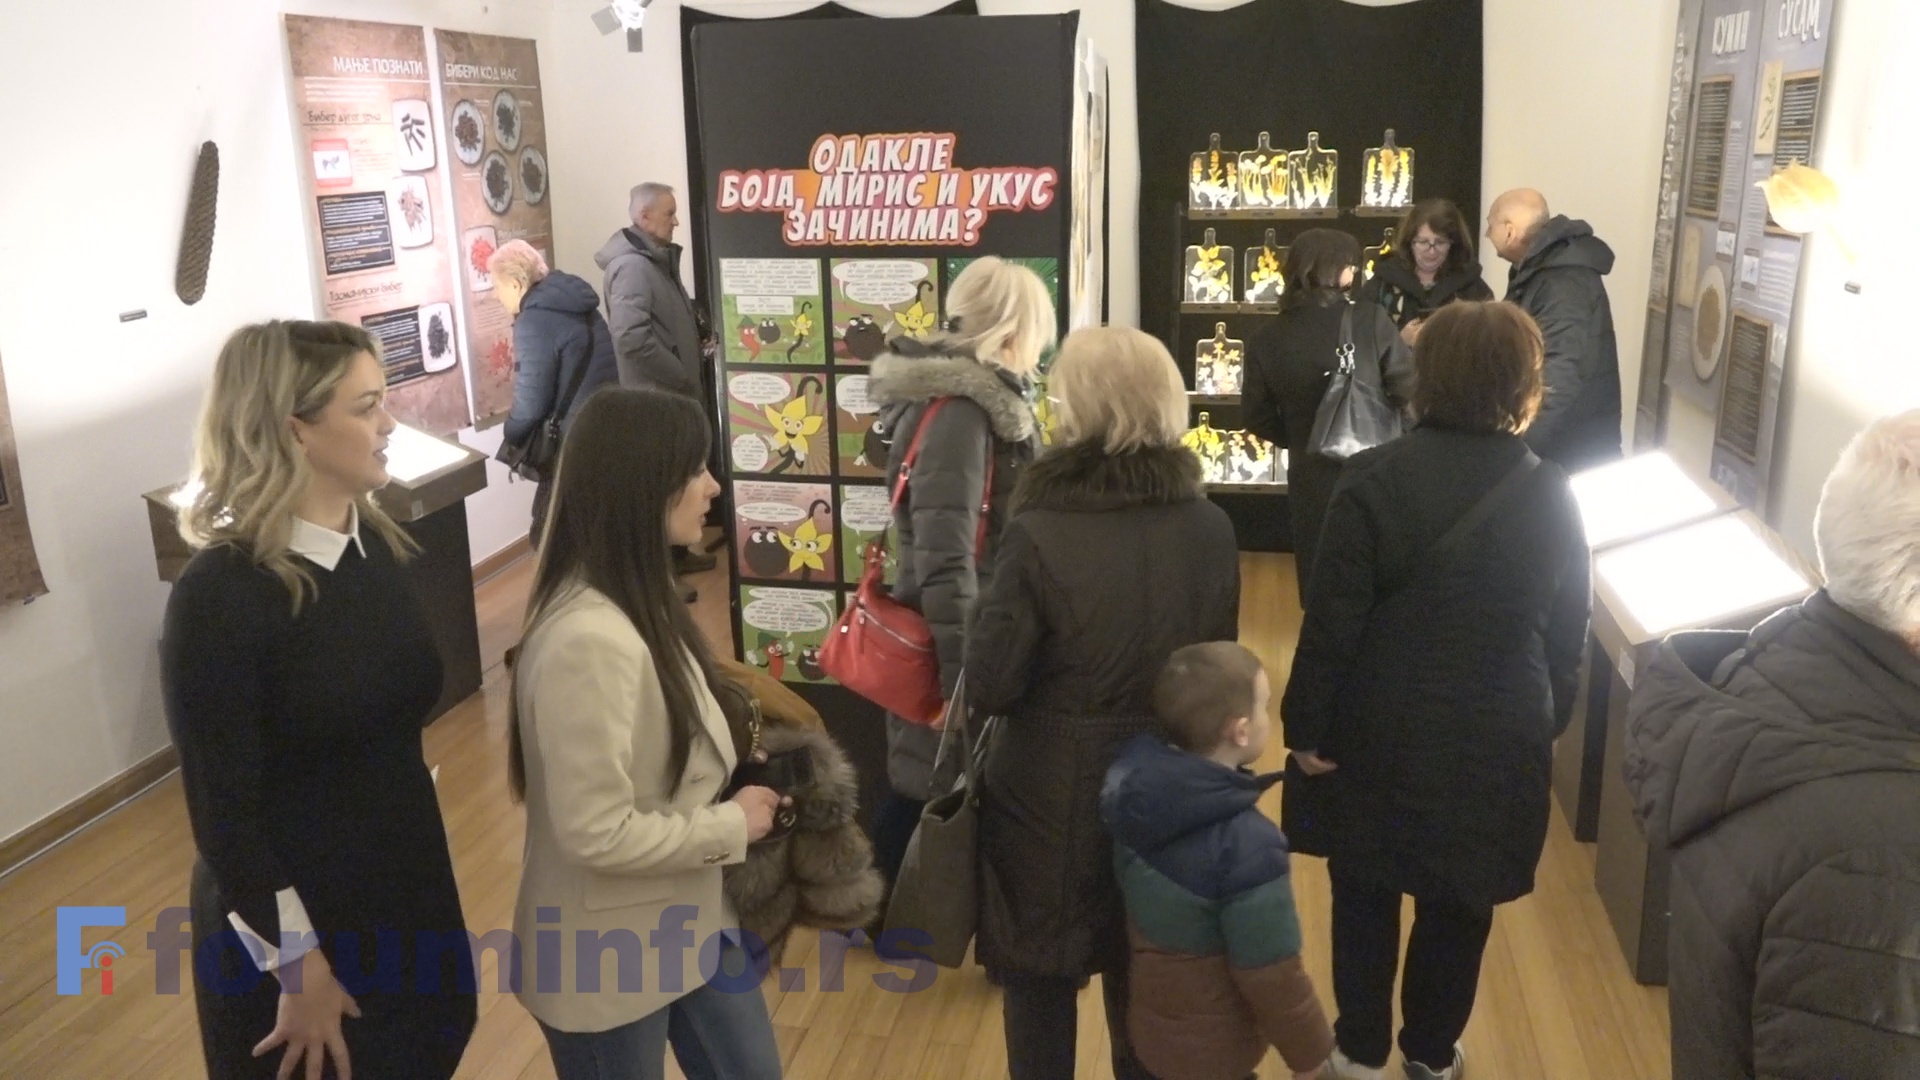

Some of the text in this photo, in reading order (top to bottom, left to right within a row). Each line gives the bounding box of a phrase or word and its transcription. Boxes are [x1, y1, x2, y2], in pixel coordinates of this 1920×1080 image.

[333, 56, 424, 75] МАЊЕ ПОЗНАТИ
[445, 63, 518, 81] БИБЕРИ КОД НАС
[813, 137, 952, 176] ОДАКЛЕ
[721, 172, 1057, 212] БОЈА, МИРИС И УКУС
[786, 207, 983, 242] ЗАЧИНИМА?
